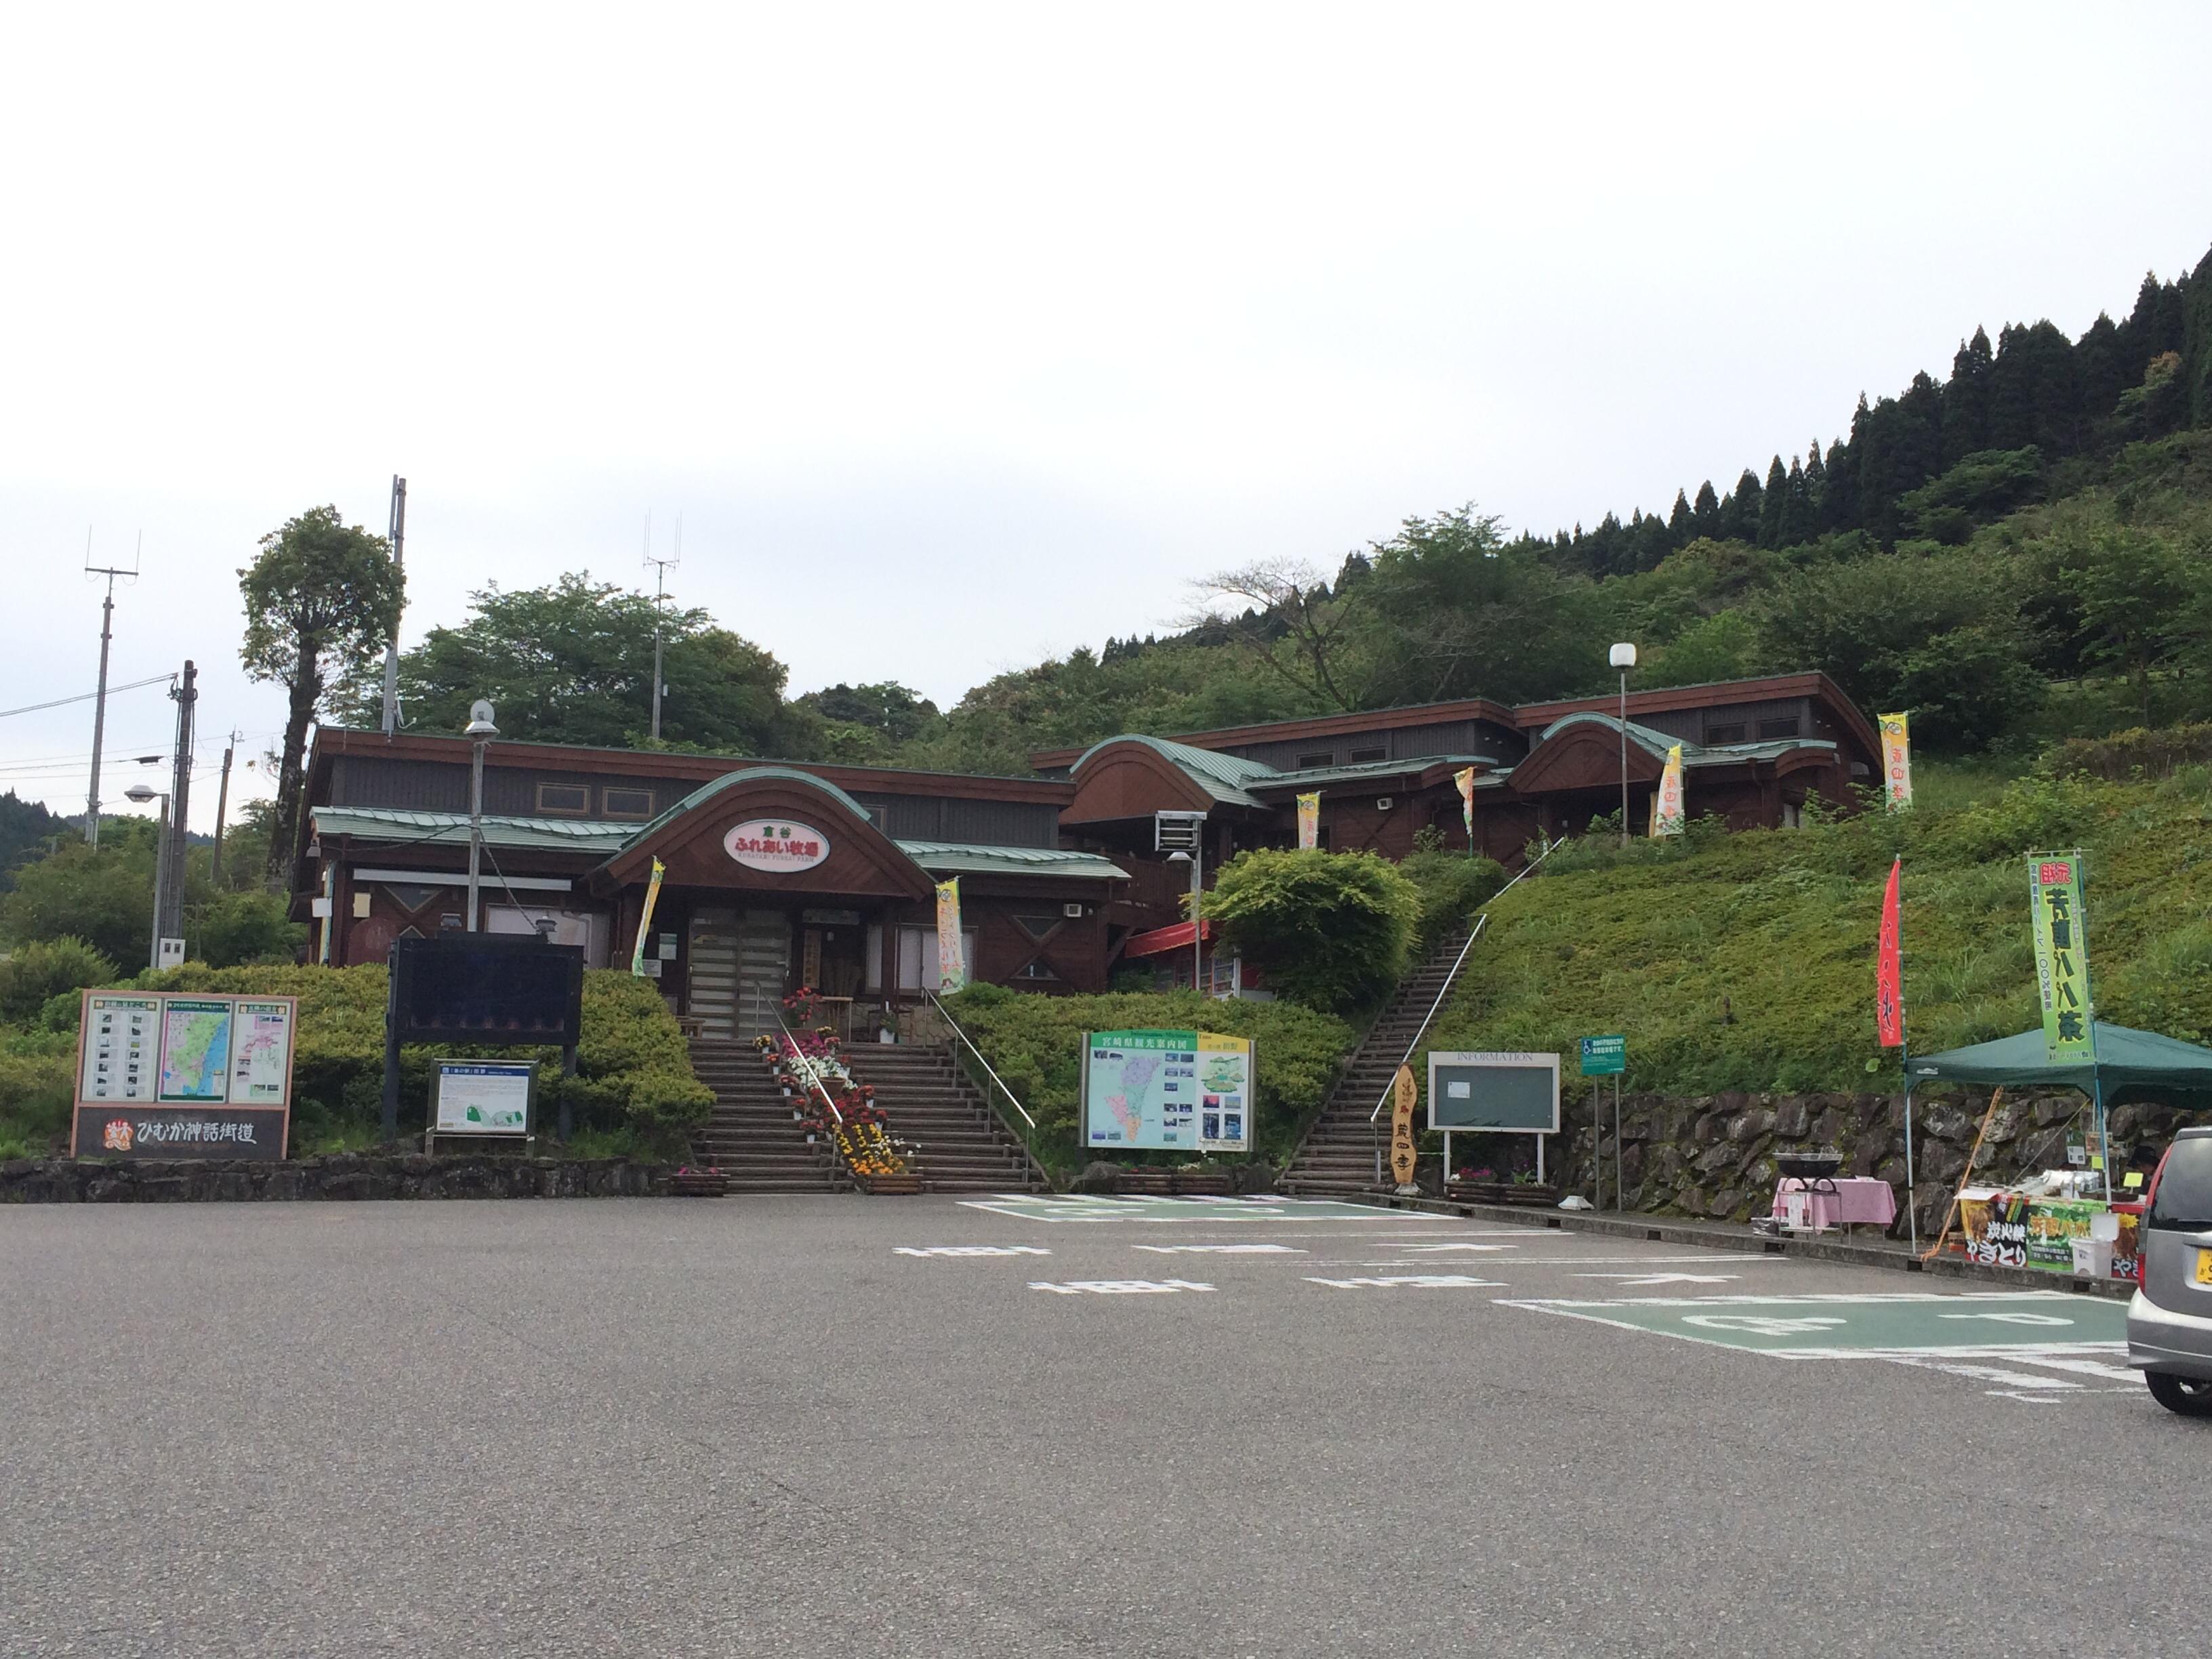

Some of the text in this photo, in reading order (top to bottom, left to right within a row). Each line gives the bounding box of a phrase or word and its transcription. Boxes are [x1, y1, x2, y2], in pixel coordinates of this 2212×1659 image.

[735, 837, 819, 857] ふれあい牧場
[1102, 1036, 1187, 1050] 宮崎県観光案内図
[1457, 1052, 1534, 1062] INFORMATION
[136, 1122, 258, 1145] ひむか神話街道
[1987, 1221, 2026, 1242] 炭火焼
[1967, 1240, 2026, 1267] やきとり
[1938, 1313, 2074, 1326] P
